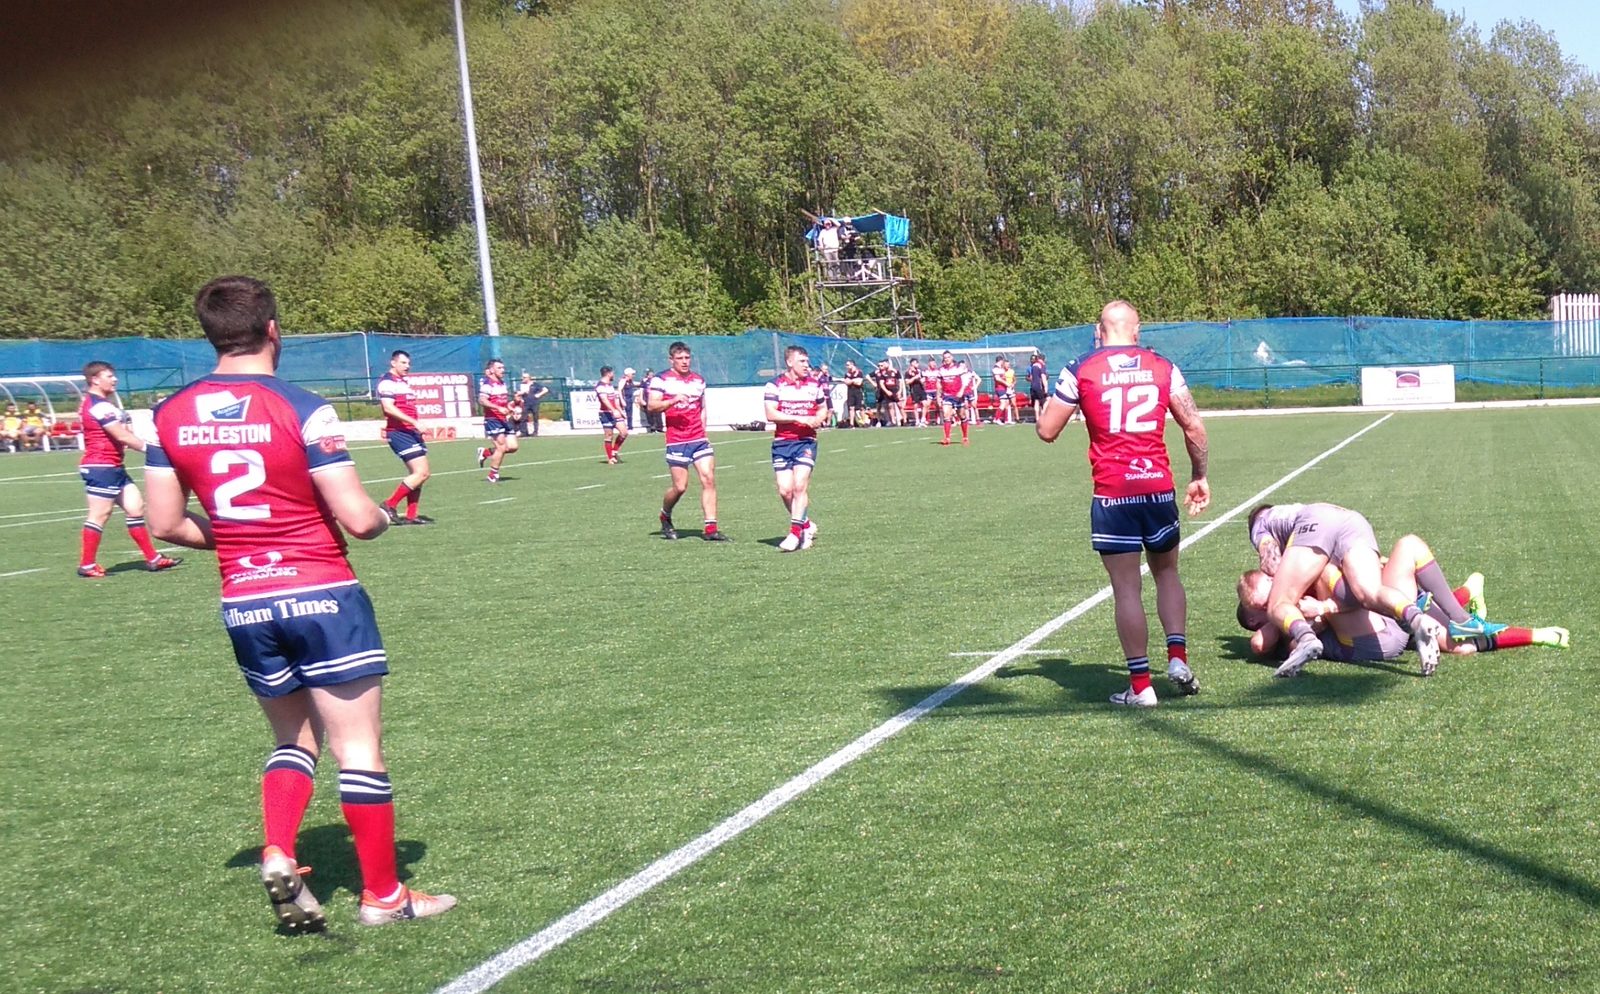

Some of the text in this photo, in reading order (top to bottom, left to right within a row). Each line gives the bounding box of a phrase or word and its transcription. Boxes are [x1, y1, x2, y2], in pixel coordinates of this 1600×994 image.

[1101, 384, 1160, 434] 12
[178, 423, 272, 446] ECCLESTON
[211, 449, 272, 520] 2
[1297, 523, 1319, 535] ISC
[274, 597, 339, 619] Times
